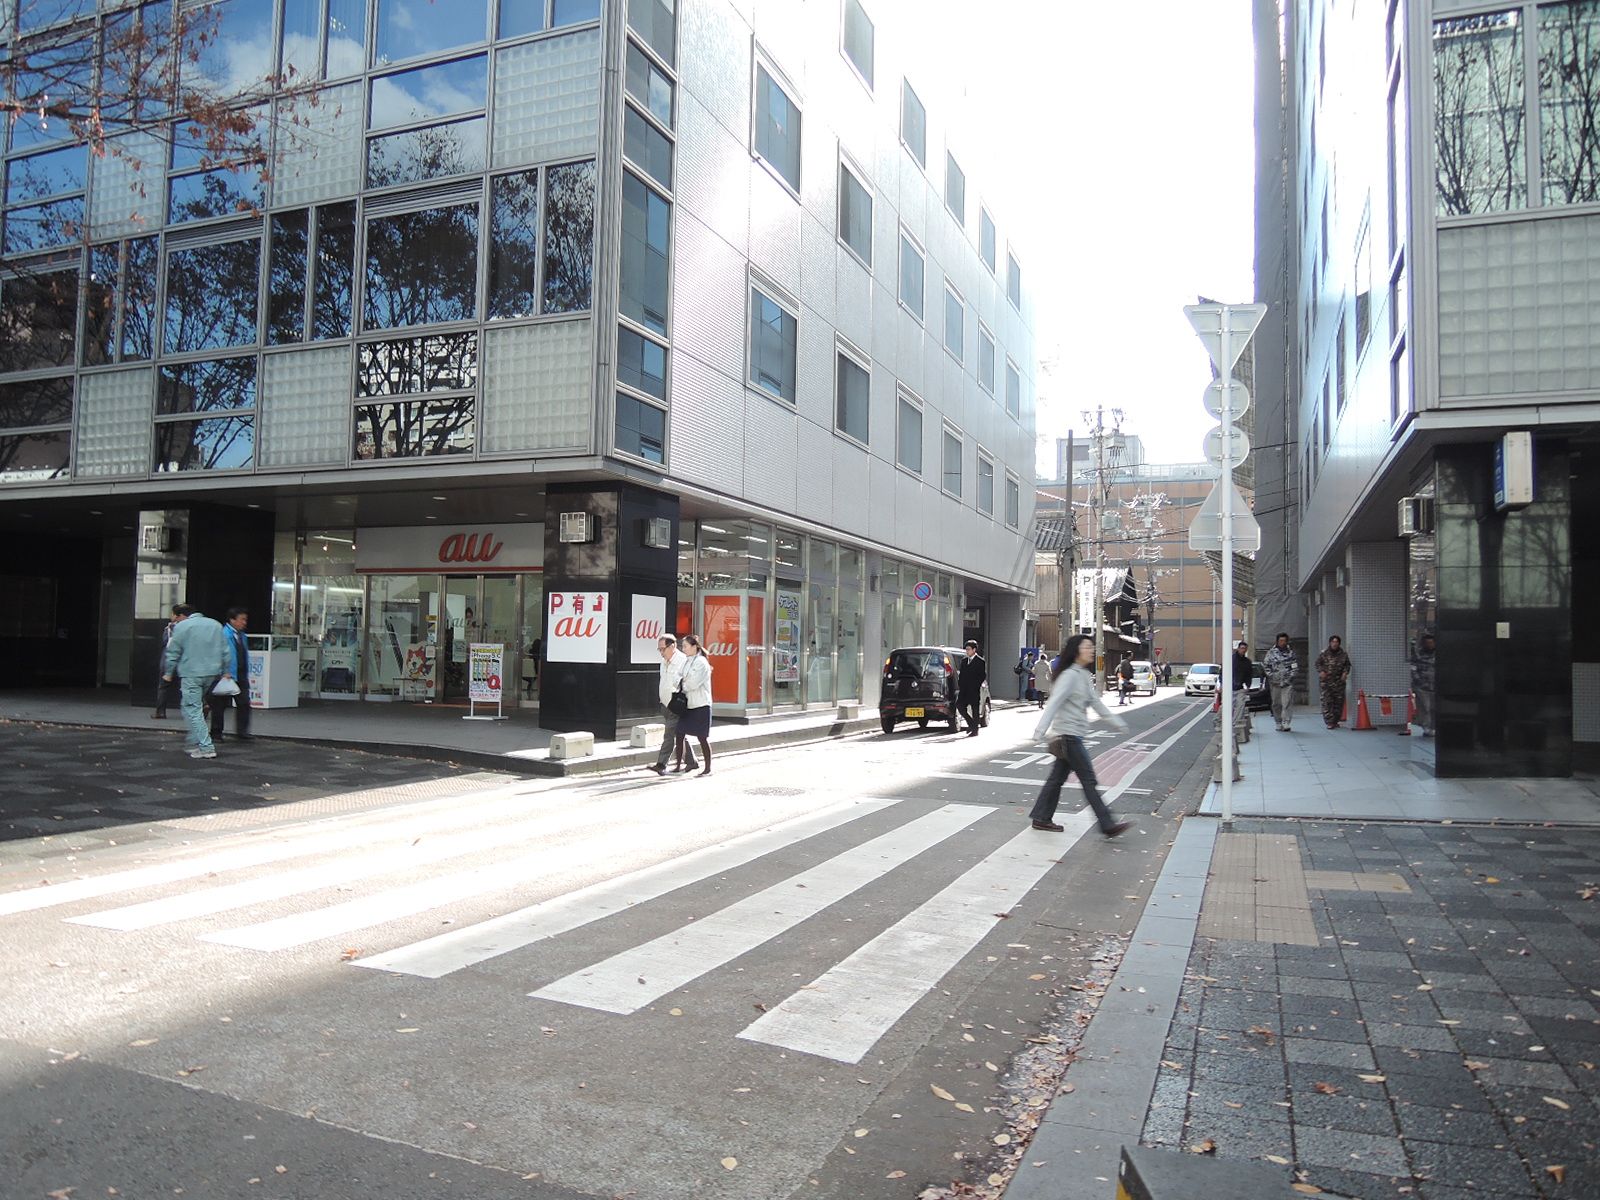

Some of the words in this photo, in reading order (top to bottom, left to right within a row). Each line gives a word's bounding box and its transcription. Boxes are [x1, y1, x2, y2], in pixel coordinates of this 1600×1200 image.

[438, 532, 504, 563] au
[1083, 576, 1091, 585] P
[551, 593, 564, 614] P
[572, 593, 585, 615] 有
[554, 616, 602, 638] au
[635, 618, 662, 639] au
[707, 642, 738, 656] au
